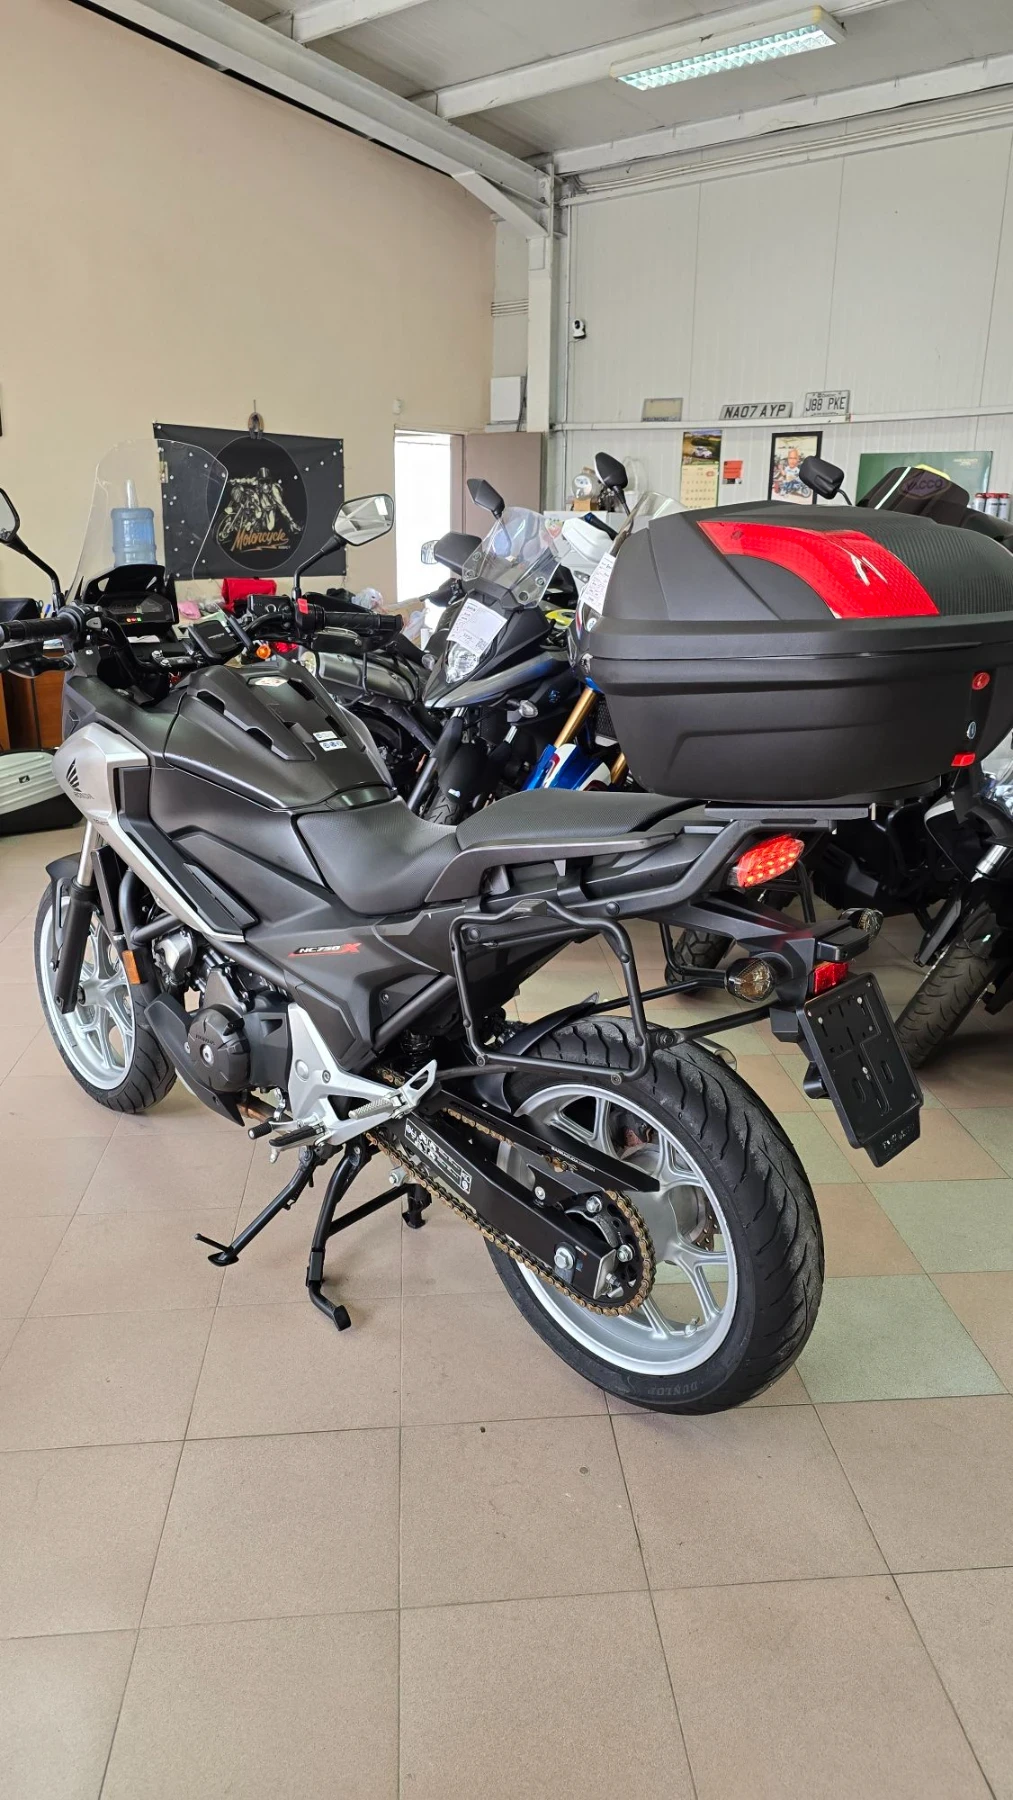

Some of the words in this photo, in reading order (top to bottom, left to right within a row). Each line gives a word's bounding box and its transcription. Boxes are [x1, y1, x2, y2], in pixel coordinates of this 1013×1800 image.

[760, 403, 786, 418] AYP
[827, 396, 847, 410] PKE
[230, 528, 290, 551] Motorcycle
[647, 1380, 698, 1396] DUNLOP
